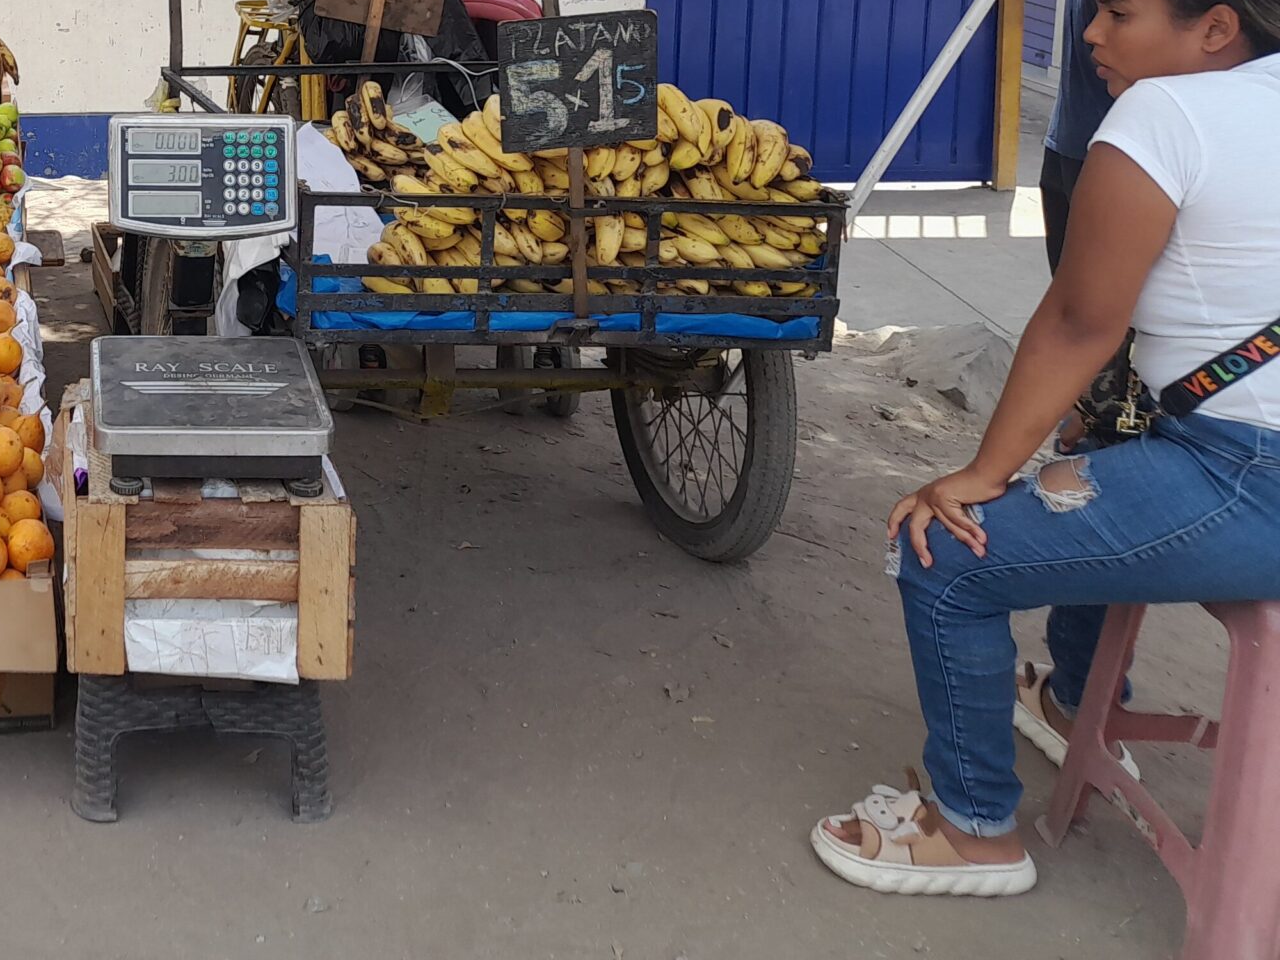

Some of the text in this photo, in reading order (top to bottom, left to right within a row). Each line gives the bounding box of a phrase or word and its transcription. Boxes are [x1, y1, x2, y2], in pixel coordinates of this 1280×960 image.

[155, 132, 199, 150] 0.000
[1211, 335, 1280, 382] LOVE
[135, 362, 278, 374] RAY SCALE
